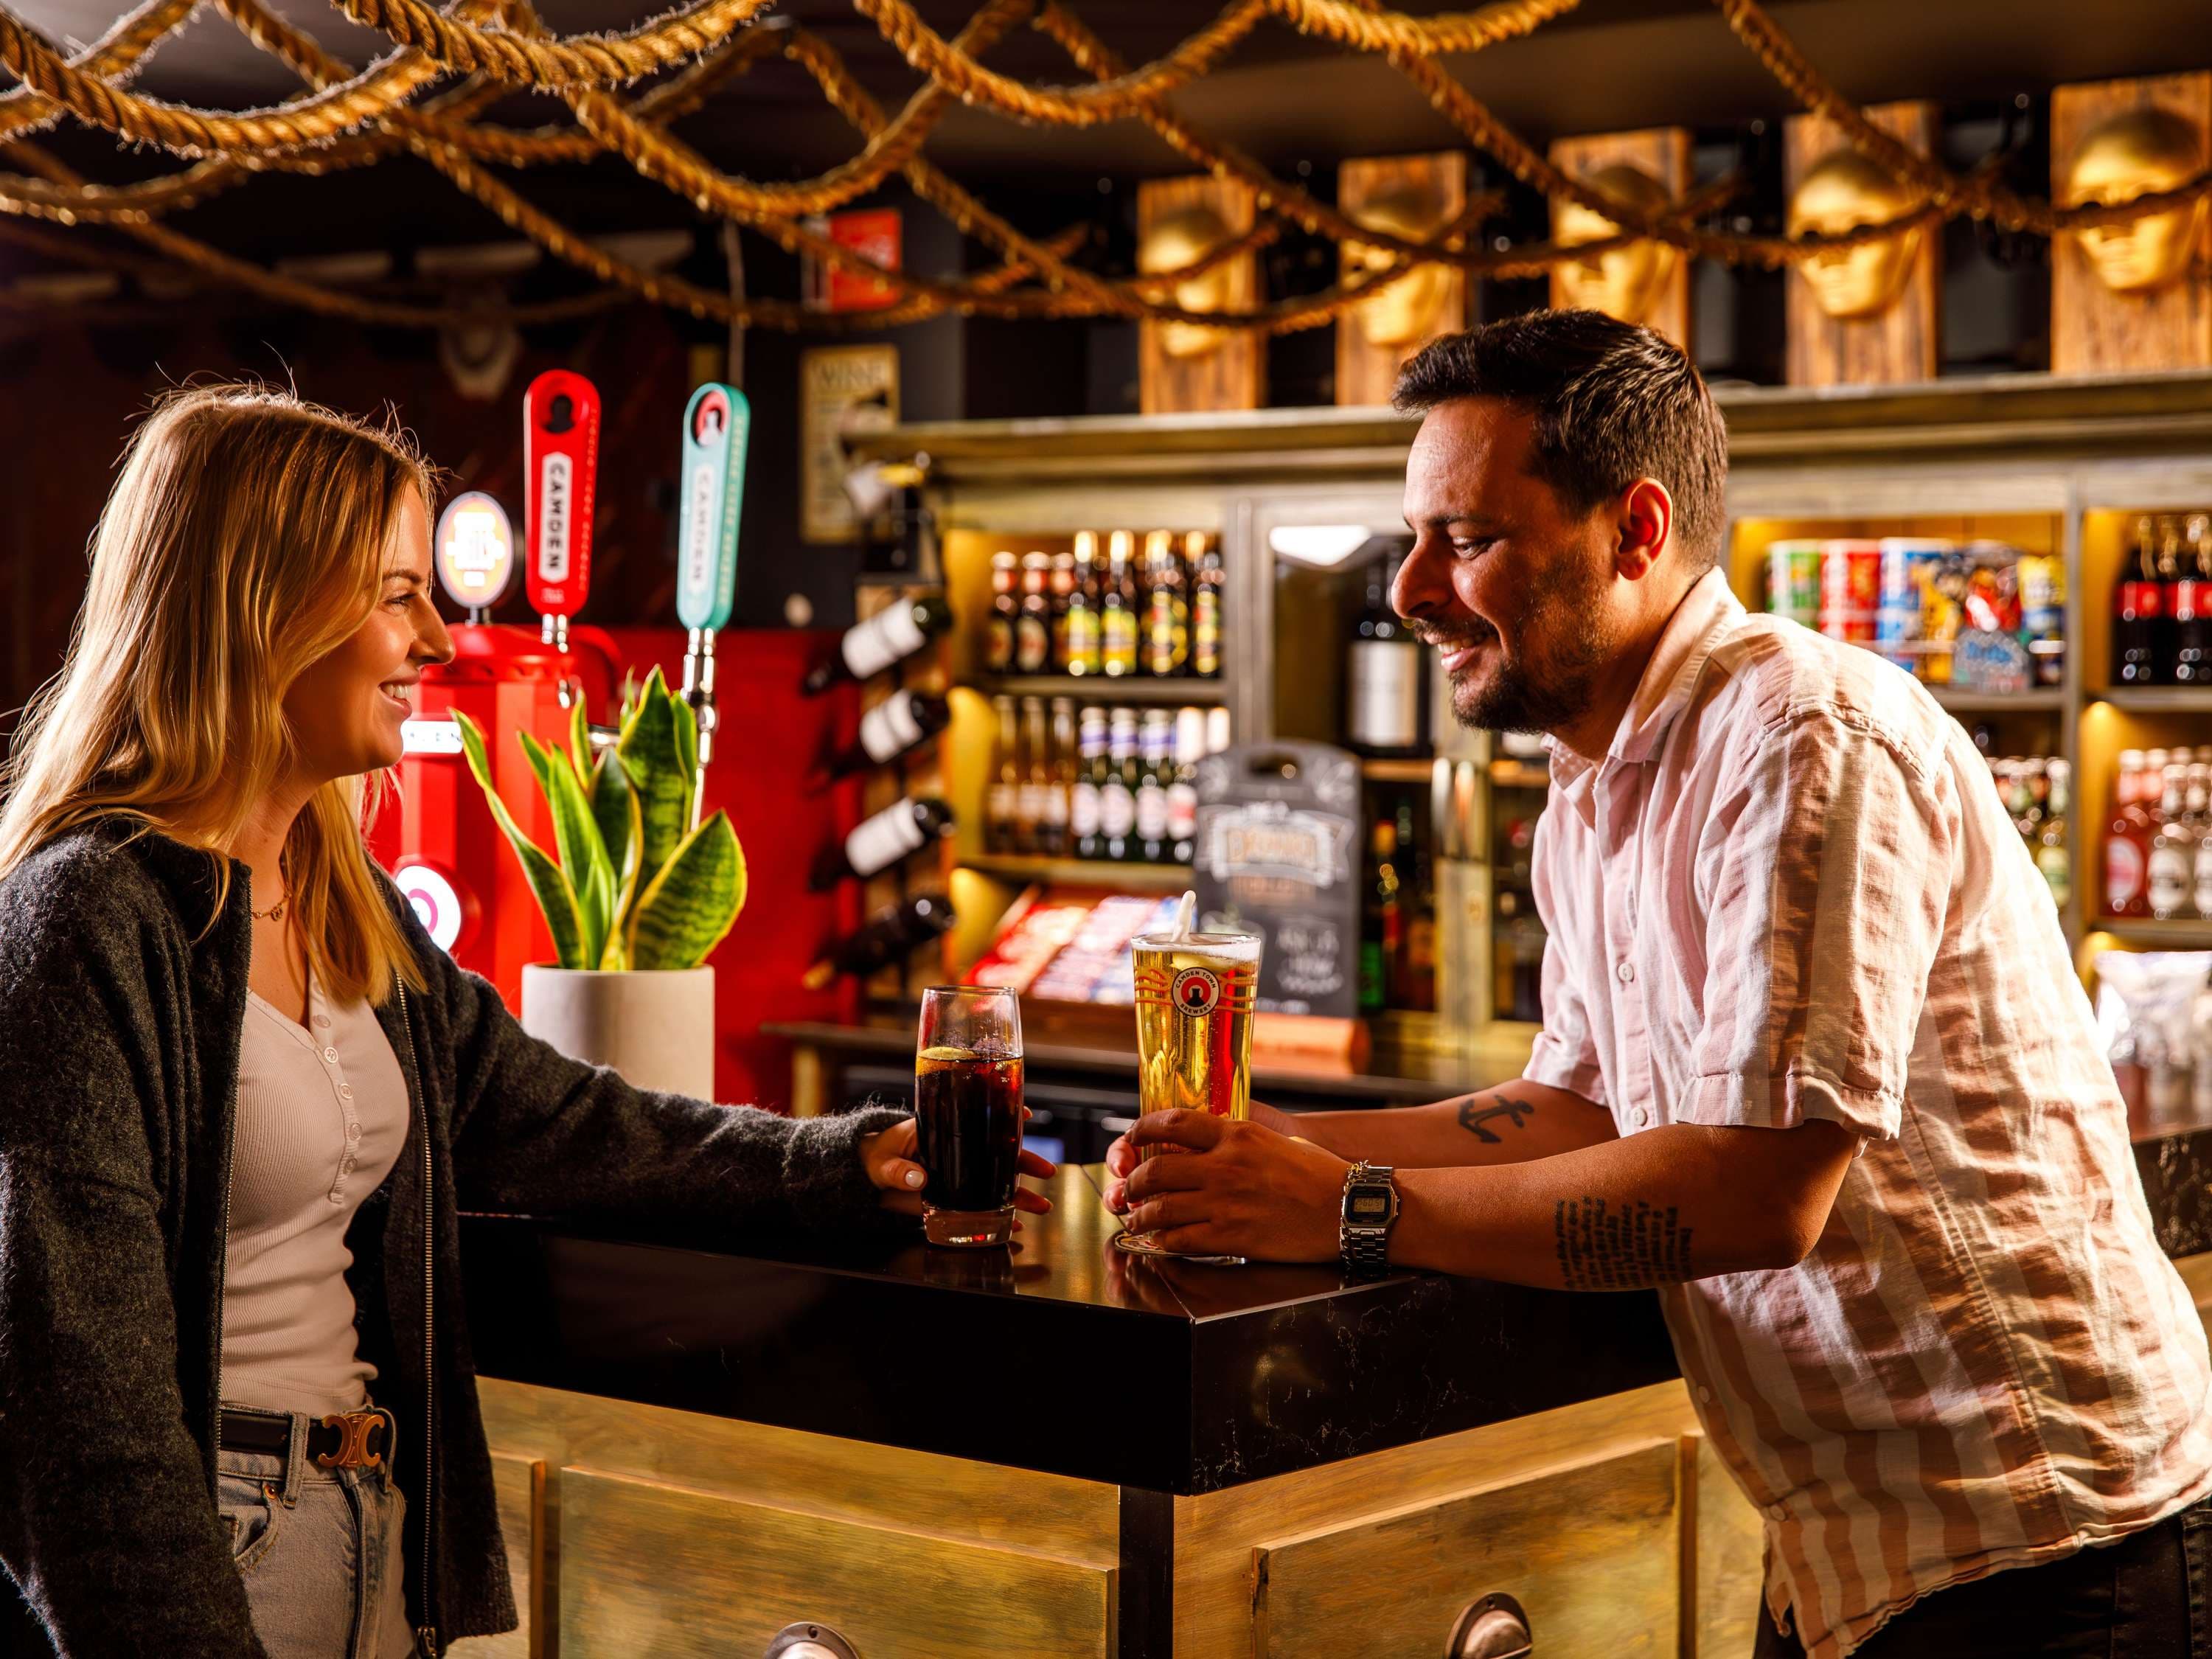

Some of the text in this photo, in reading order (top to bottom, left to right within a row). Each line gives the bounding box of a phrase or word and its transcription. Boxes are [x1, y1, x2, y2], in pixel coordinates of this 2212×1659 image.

[549, 462, 566, 569] CAMDEN
[694, 470, 709, 580] CAMDEN
[1175, 970, 1217, 988] CAMDEN TOWN
[1180, 1003, 1211, 1014] BREWERY
